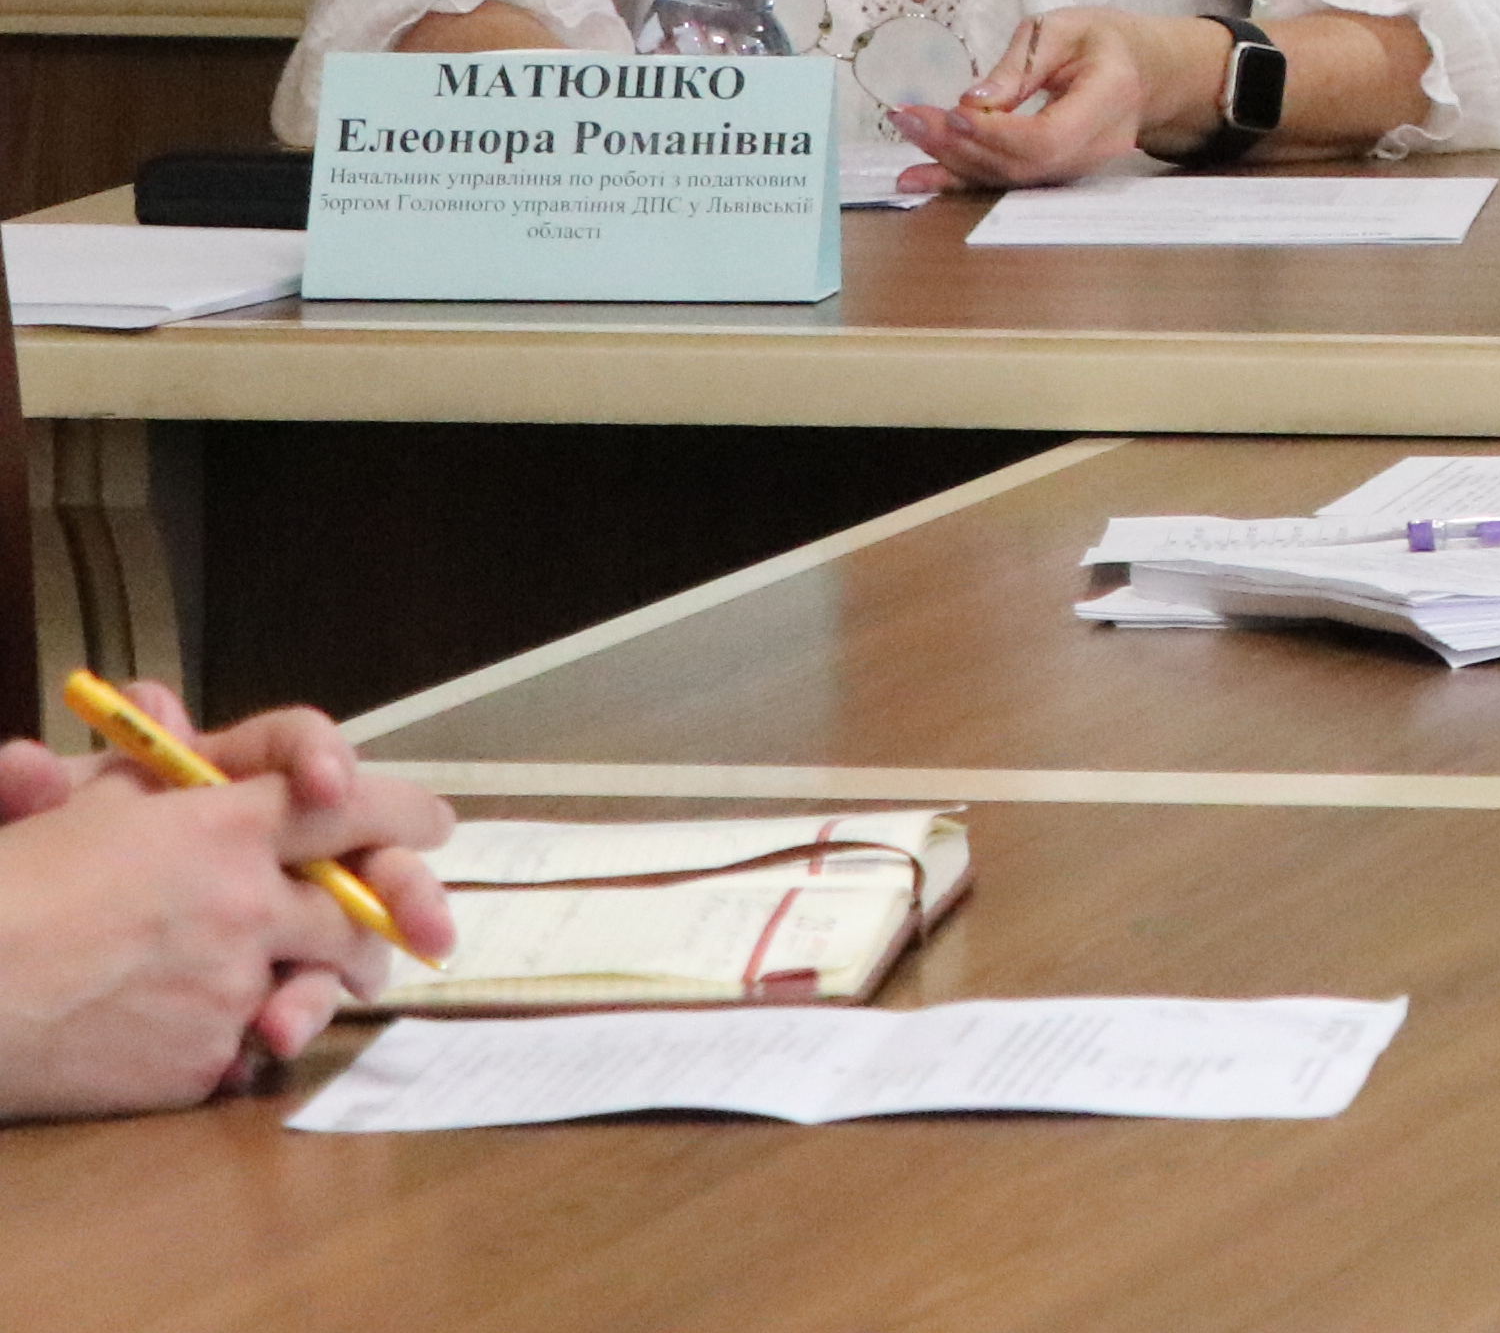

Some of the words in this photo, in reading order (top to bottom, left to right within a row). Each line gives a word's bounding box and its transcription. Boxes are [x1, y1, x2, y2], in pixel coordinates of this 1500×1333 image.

[436, 63, 745, 100] МАТЮШКО
[338, 118, 555, 164] Елеонора
[575, 121, 812, 156] Романівна
[330, 167, 440, 185] Начальник
[446, 173, 562, 191] управління
[569, 174, 594, 187] по
[599, 169, 665, 192] роботі
[687, 174, 807, 188] податковим
[397, 193, 506, 212] Головного
[511, 199, 626, 217] управління
[631, 196, 682, 216] ДПС
[705, 196, 815, 214] Львівській
[526, 221, 601, 240] області
